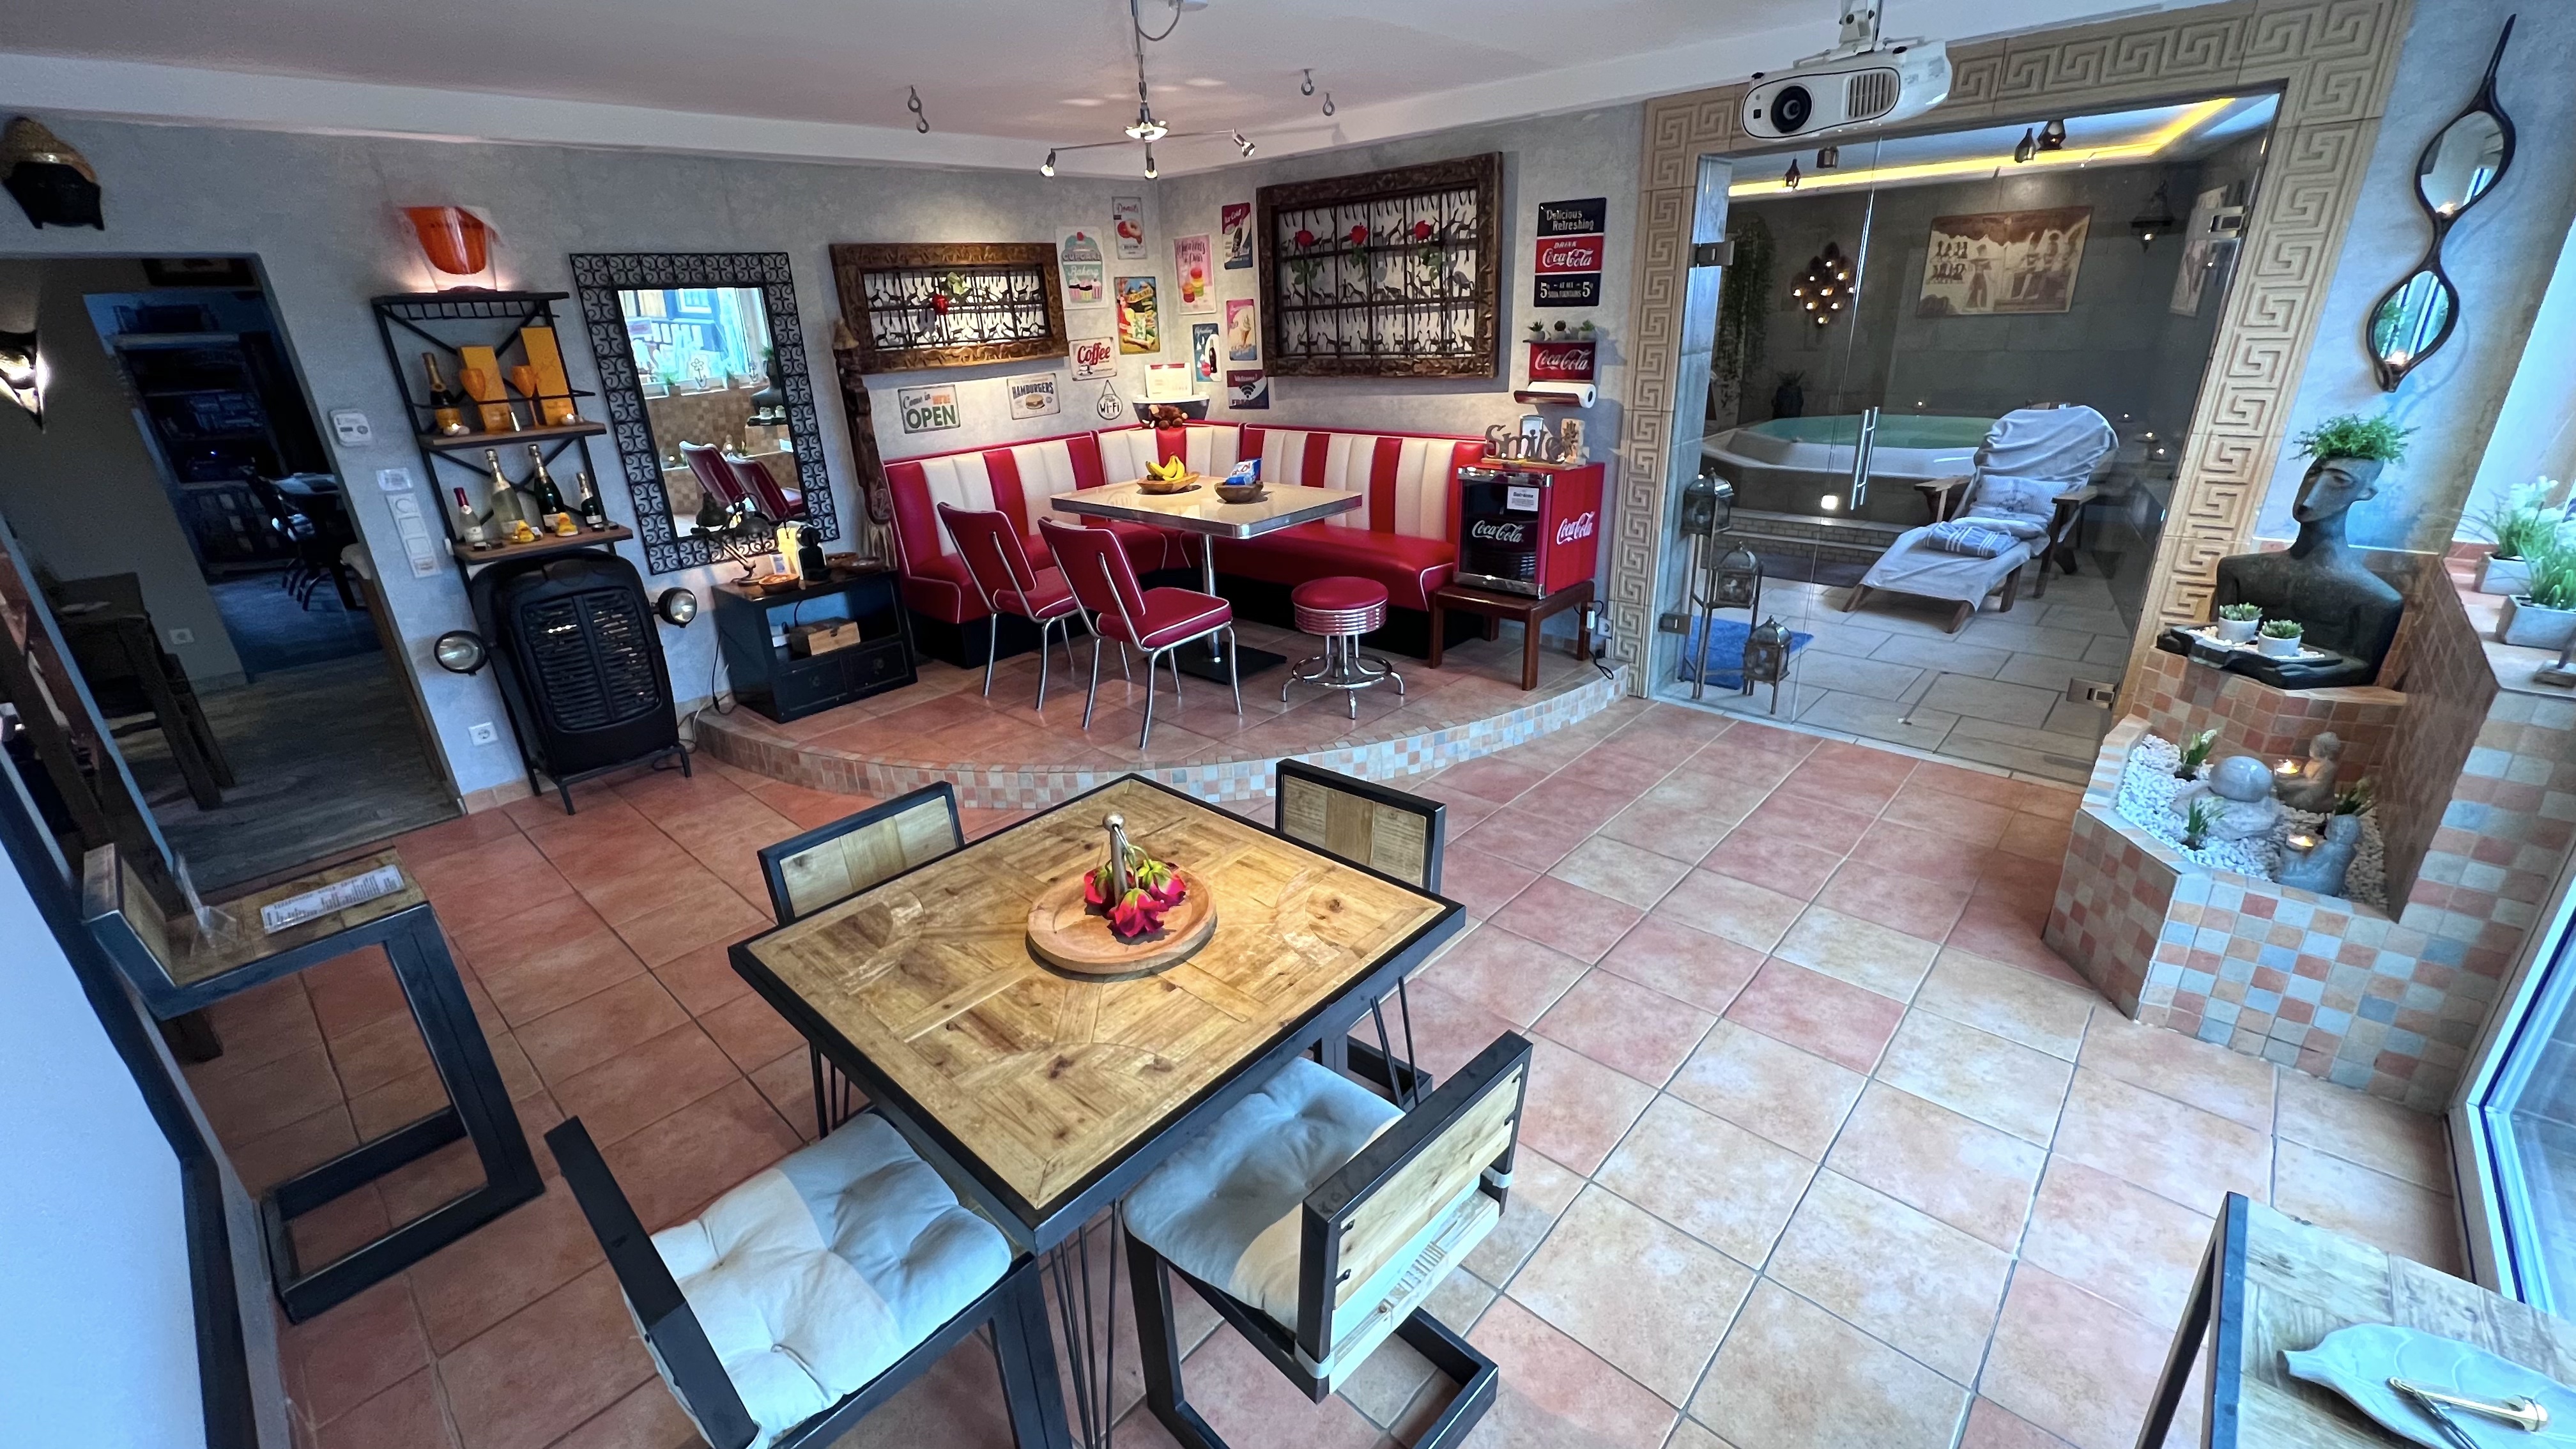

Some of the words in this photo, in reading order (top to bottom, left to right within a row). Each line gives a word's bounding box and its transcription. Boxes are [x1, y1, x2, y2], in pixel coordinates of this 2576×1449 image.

[1547, 210, 1582, 220] Delicious
[1552, 218, 1594, 231] Refreshing
[1068, 265, 1099, 279] Bakery
[1077, 342, 1111, 365] Coffee
[1012, 381, 1054, 399] HAMBURGERS
[906, 405, 956, 429] OPEN
[1484, 424, 1565, 463] Smile
